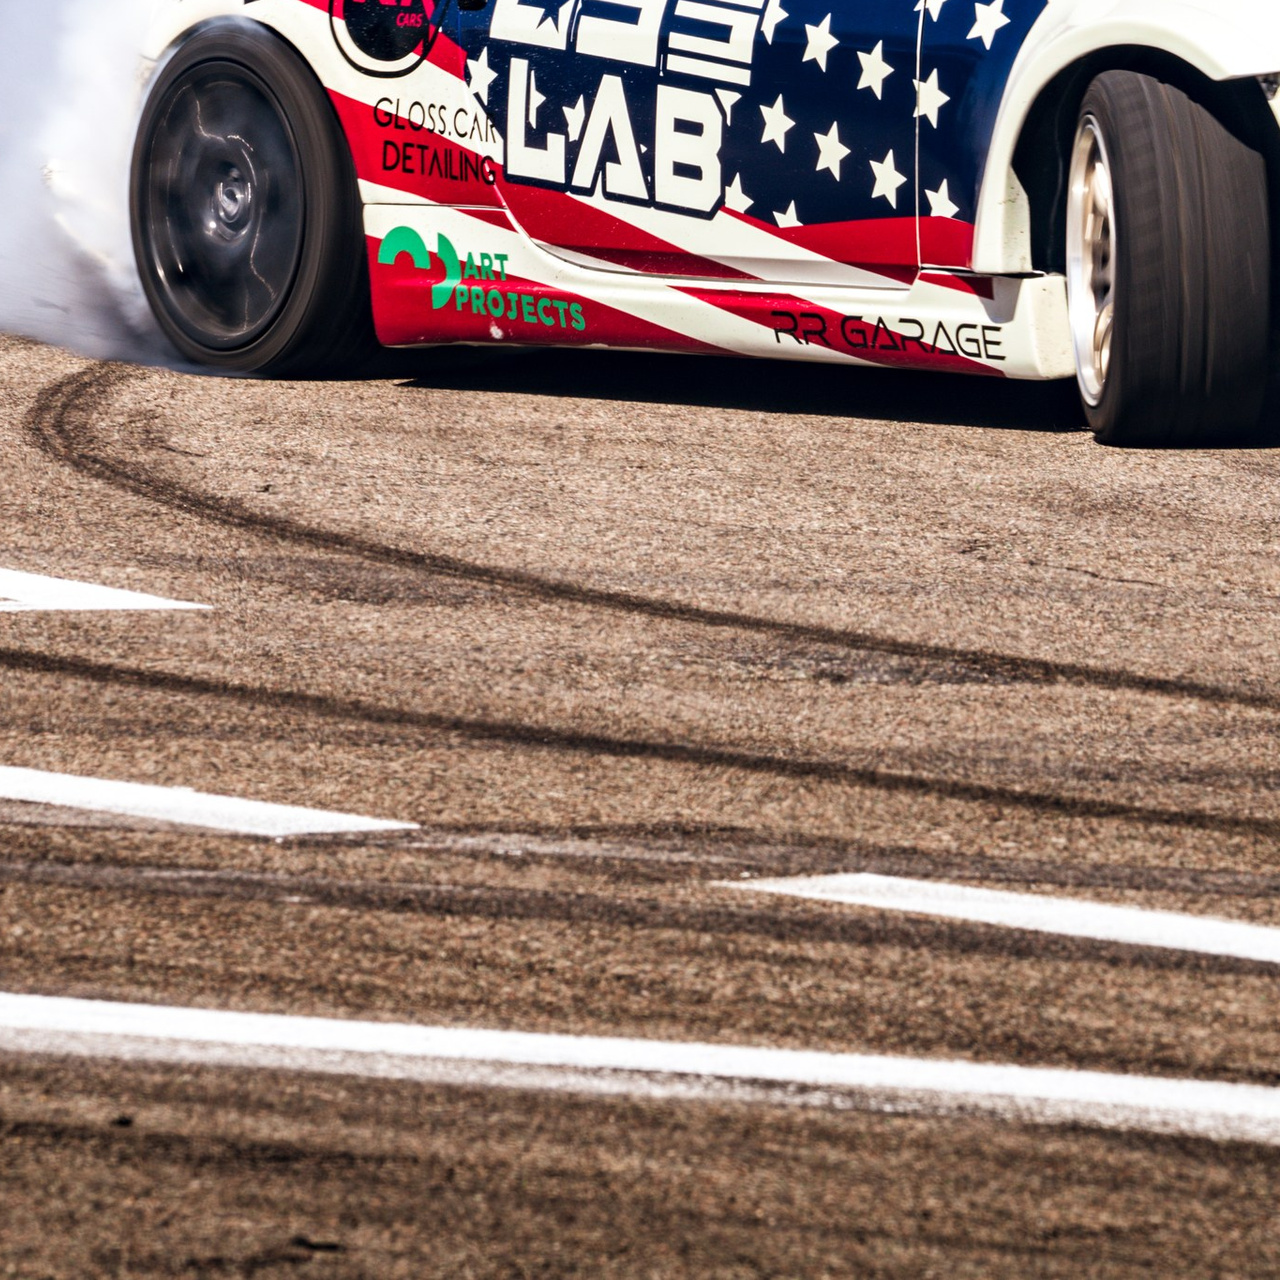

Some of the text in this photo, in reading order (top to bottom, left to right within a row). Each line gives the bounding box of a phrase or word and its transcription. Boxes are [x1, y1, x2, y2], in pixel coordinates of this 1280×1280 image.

[396, 12, 423, 27] CARS
[507, 57, 723, 212] LAB
[382, 140, 496, 185] DETAILING
[464, 251, 509, 281] ART
[455, 284, 586, 331] PROJECTS
[771, 310, 1006, 361] RR GARAGE
